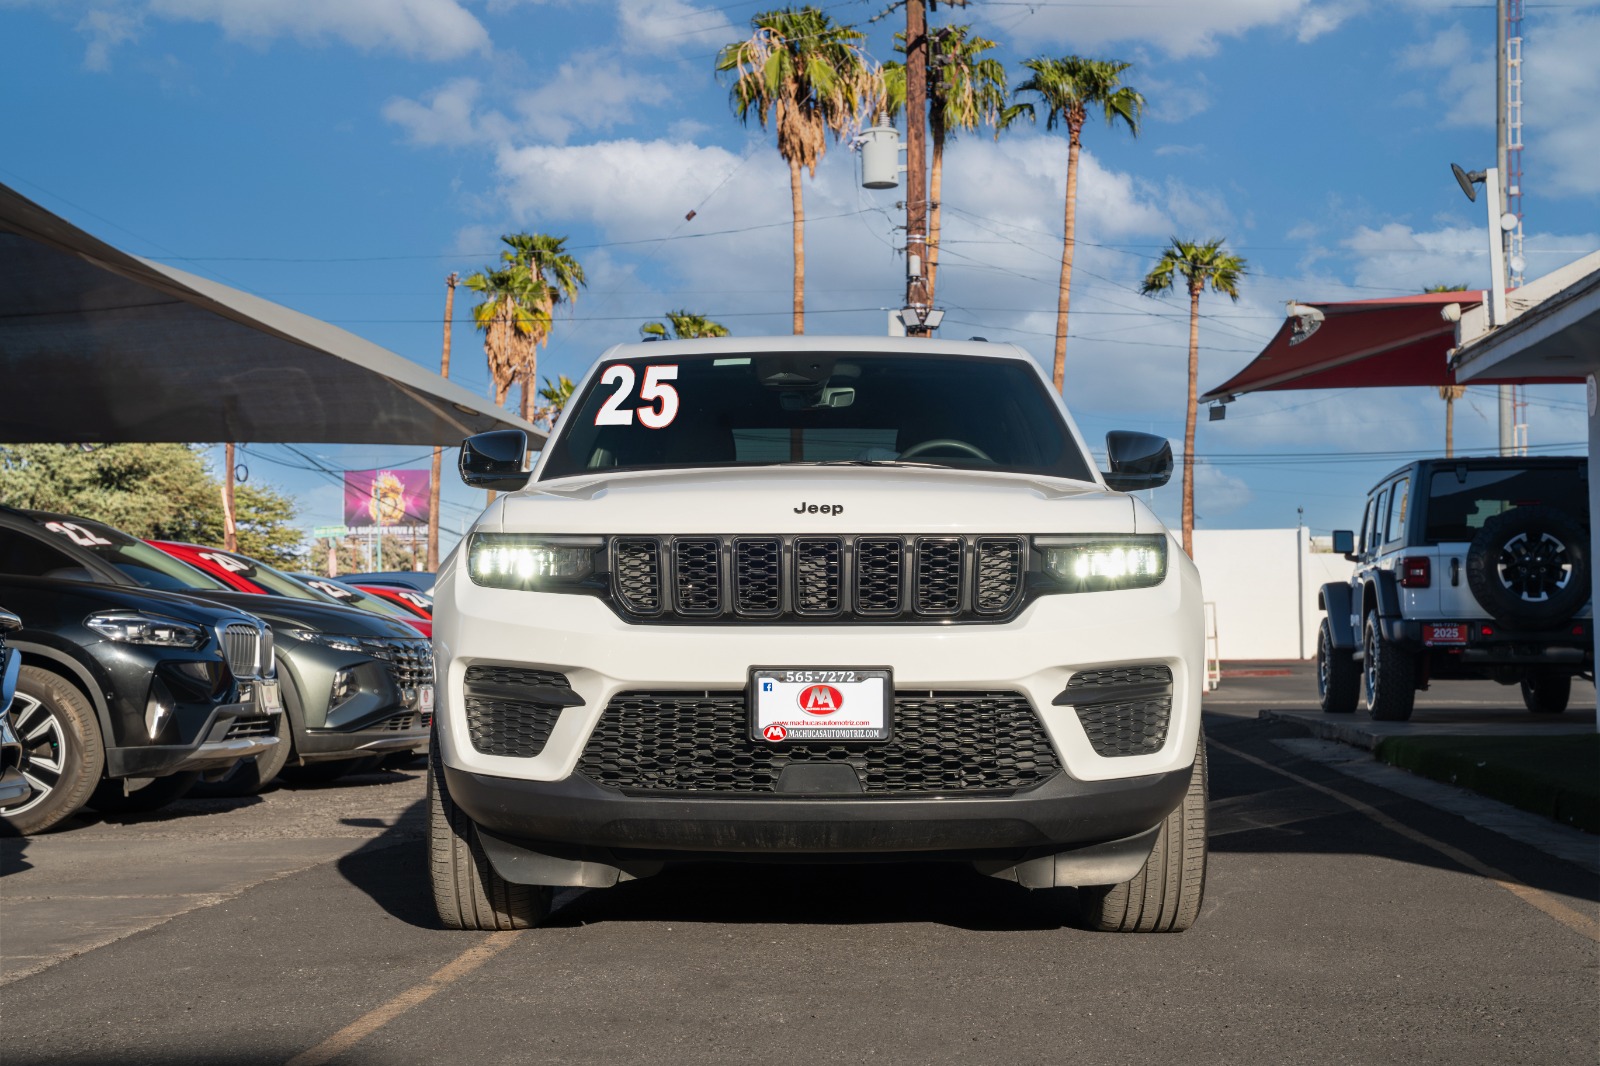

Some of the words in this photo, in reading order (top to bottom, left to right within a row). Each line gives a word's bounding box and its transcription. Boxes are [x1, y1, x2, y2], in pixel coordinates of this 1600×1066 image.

[594, 363, 679, 429] 25
[793, 501, 844, 516] Jeep
[44, 521, 112, 546] 22
[1433, 628, 1459, 638] 2025
[786, 671, 855, 682] 565-7272
[789, 729, 880, 738] MACHUCASAUTOMOTRIZ.COM
